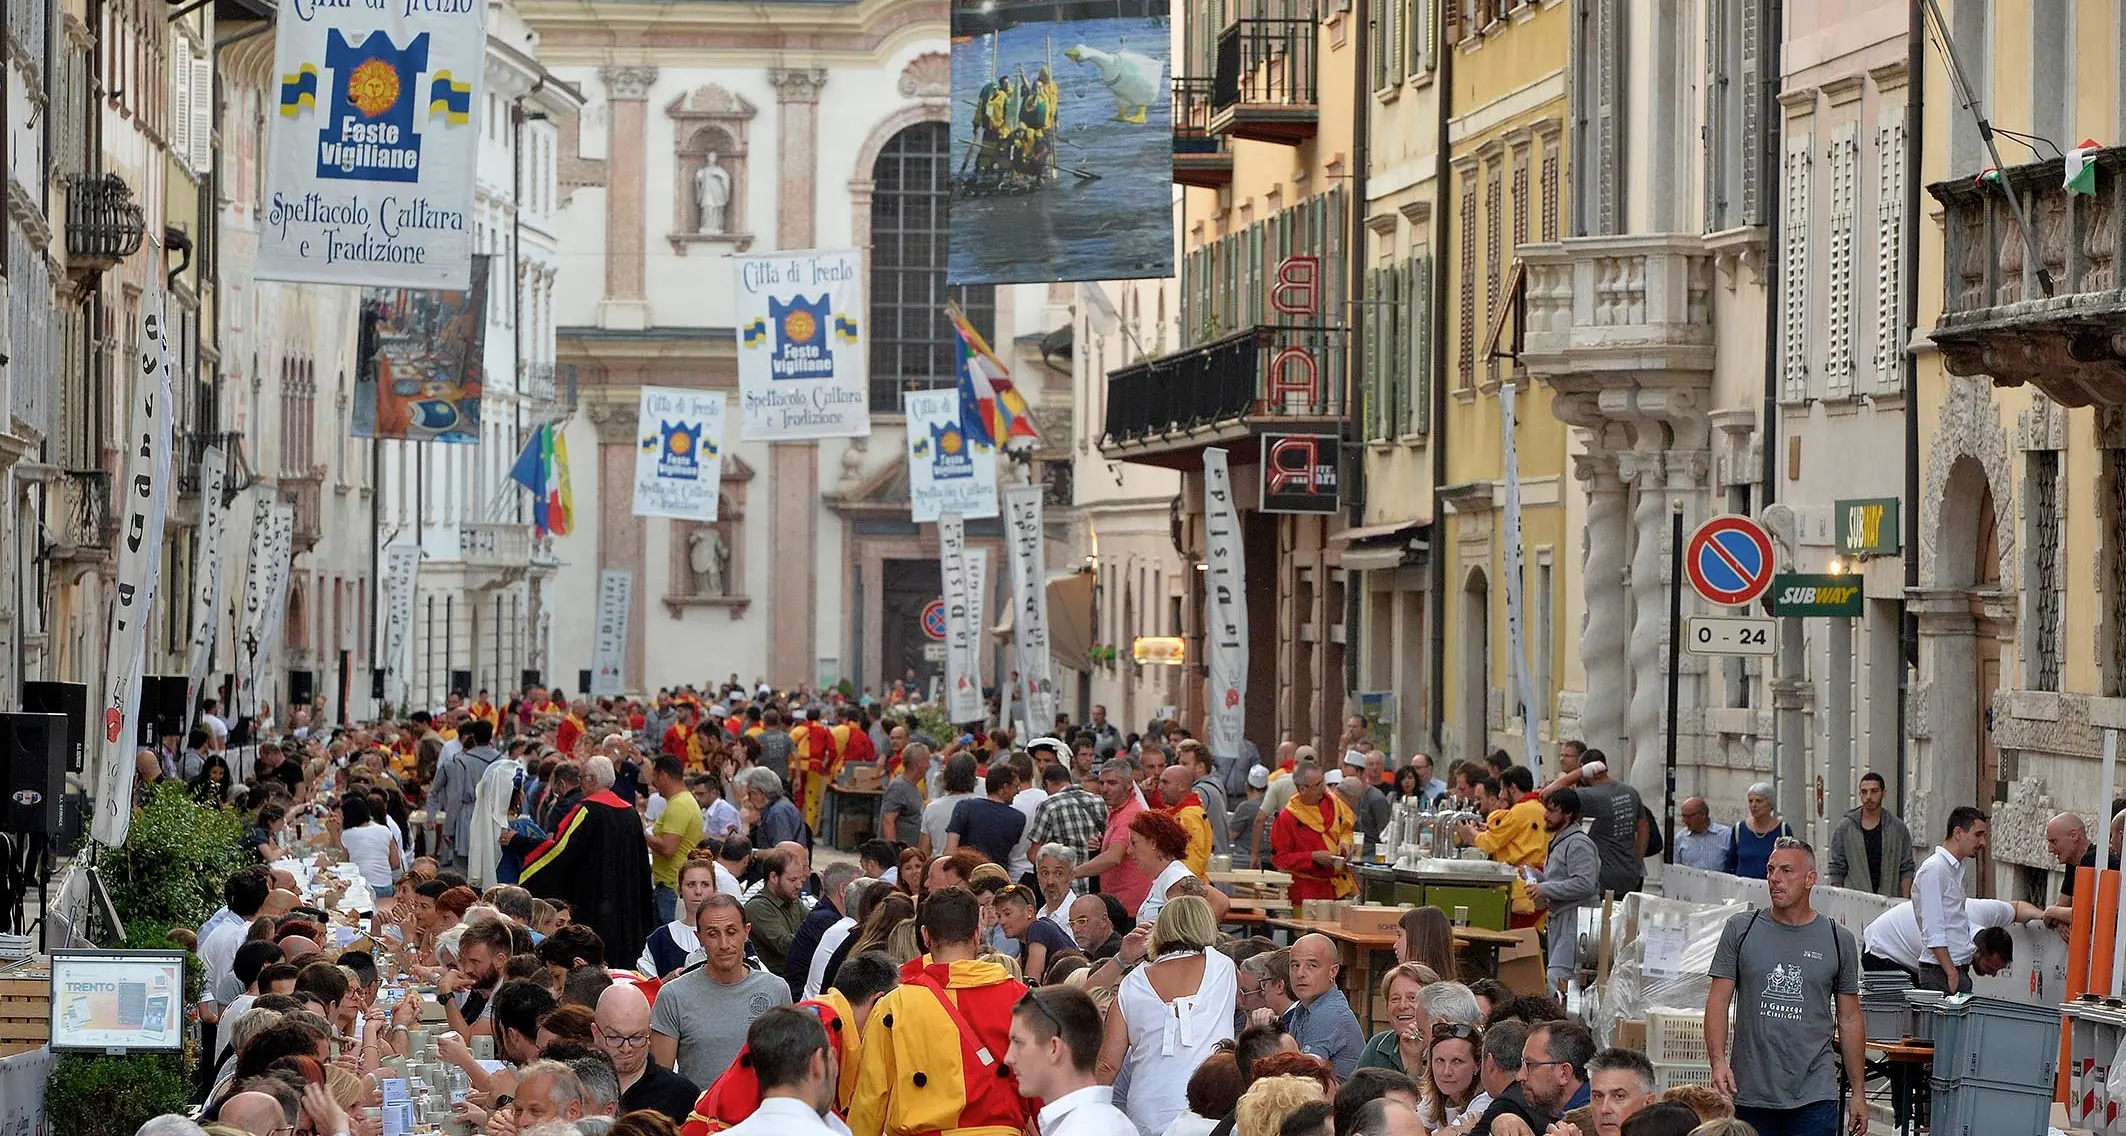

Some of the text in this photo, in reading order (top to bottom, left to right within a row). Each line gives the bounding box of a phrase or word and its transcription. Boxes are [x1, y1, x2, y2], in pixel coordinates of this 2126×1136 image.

[341, 115, 399, 145] Feste
[321, 141, 417, 173] Vigiliane
[379, 197, 463, 238] Cultura
[300, 228, 426, 265] e Tradizione
[787, 259, 801, 283] di
[808, 257, 853, 286] Trento
[783, 343, 820, 360] Feste
[772, 357, 833, 377] Vigiliane
[812, 386, 863, 412] Cultura
[782, 408, 844, 429] Tradizione
[1846, 504, 1883, 549] SUBWAY
[1210, 467, 1239, 648] la Disfida
[944, 524, 967, 649] la Disfida
[1778, 586, 1858, 605] SUBWAY
[1698, 627, 1712, 643] 0
[1739, 629, 1767, 645] 24
[65, 982, 116, 992] TRENTO
